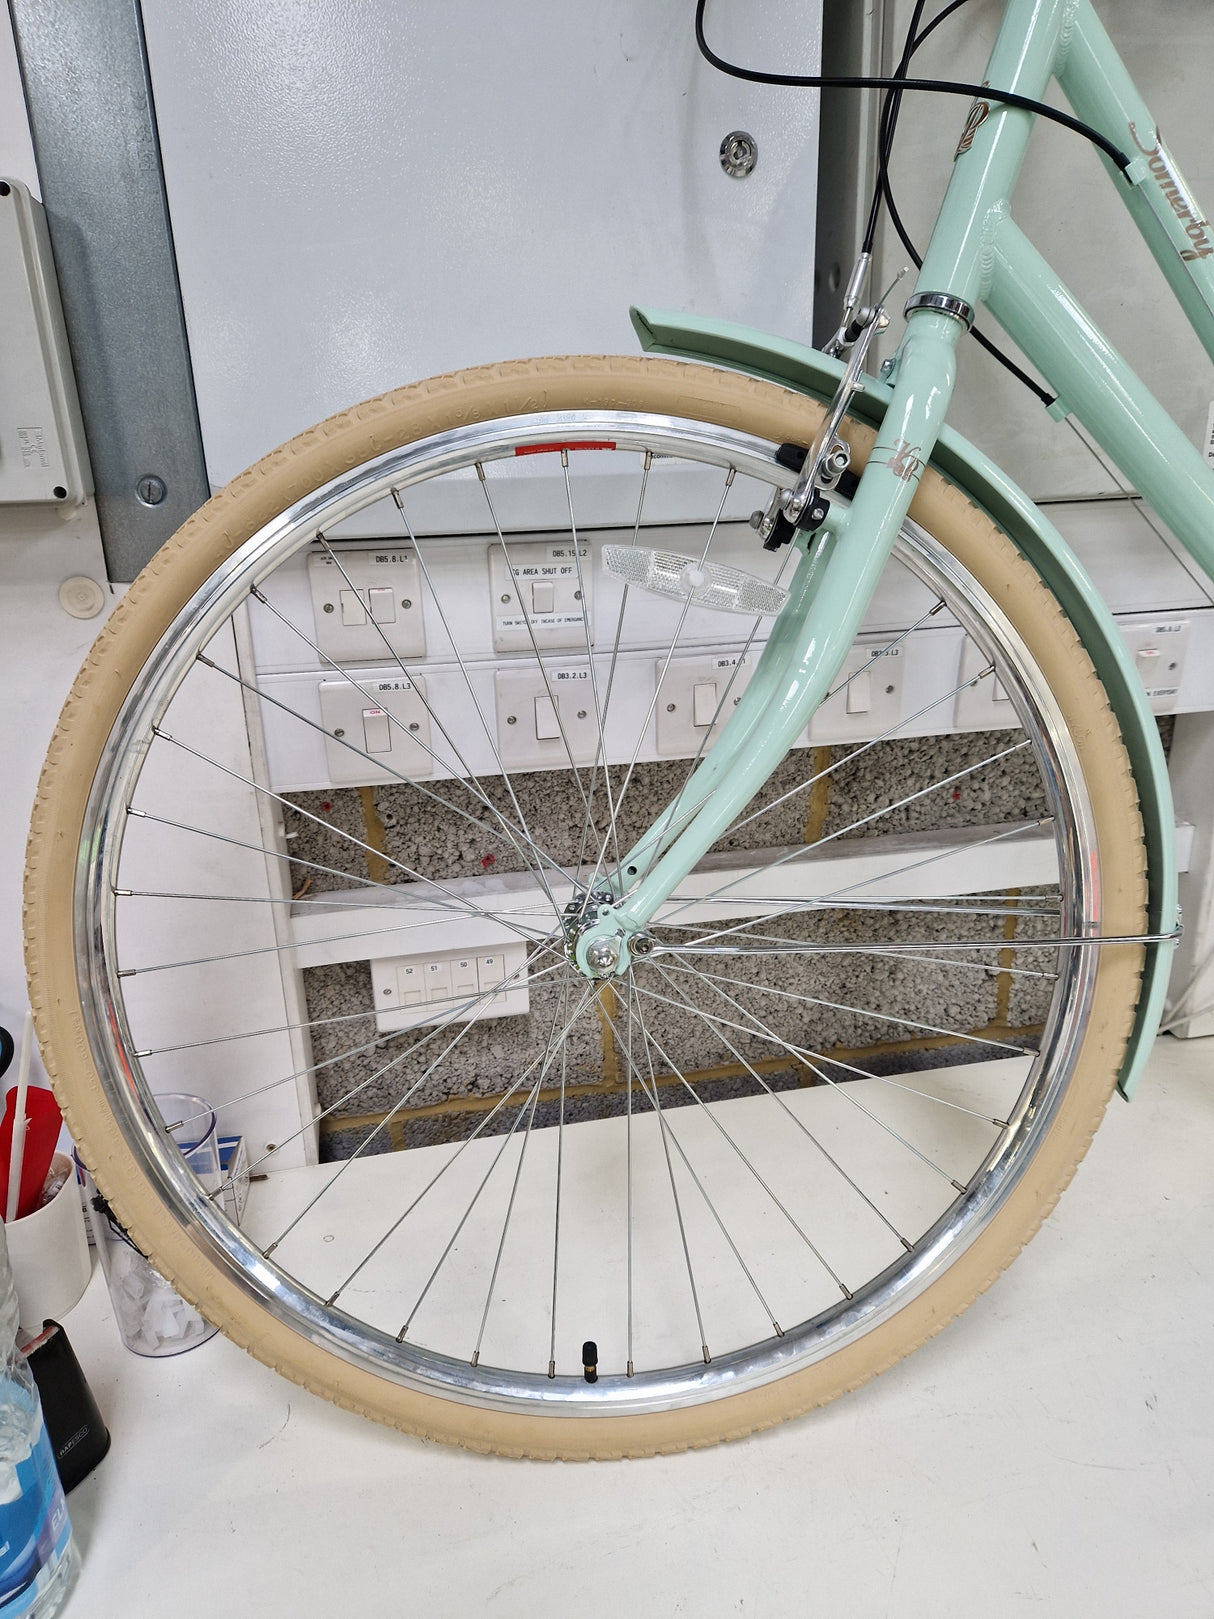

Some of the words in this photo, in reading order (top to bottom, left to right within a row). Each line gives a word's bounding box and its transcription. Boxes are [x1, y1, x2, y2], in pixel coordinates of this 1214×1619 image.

[552, 549, 587, 558] DB5.15L2
[541, 567, 557, 575] SHUT
[560, 566, 573, 574] OFF
[557, 671, 588, 680] DB3.2.L3
[378, 682, 411, 691] DB5.8.L3
[406, 967, 413, 975] 52
